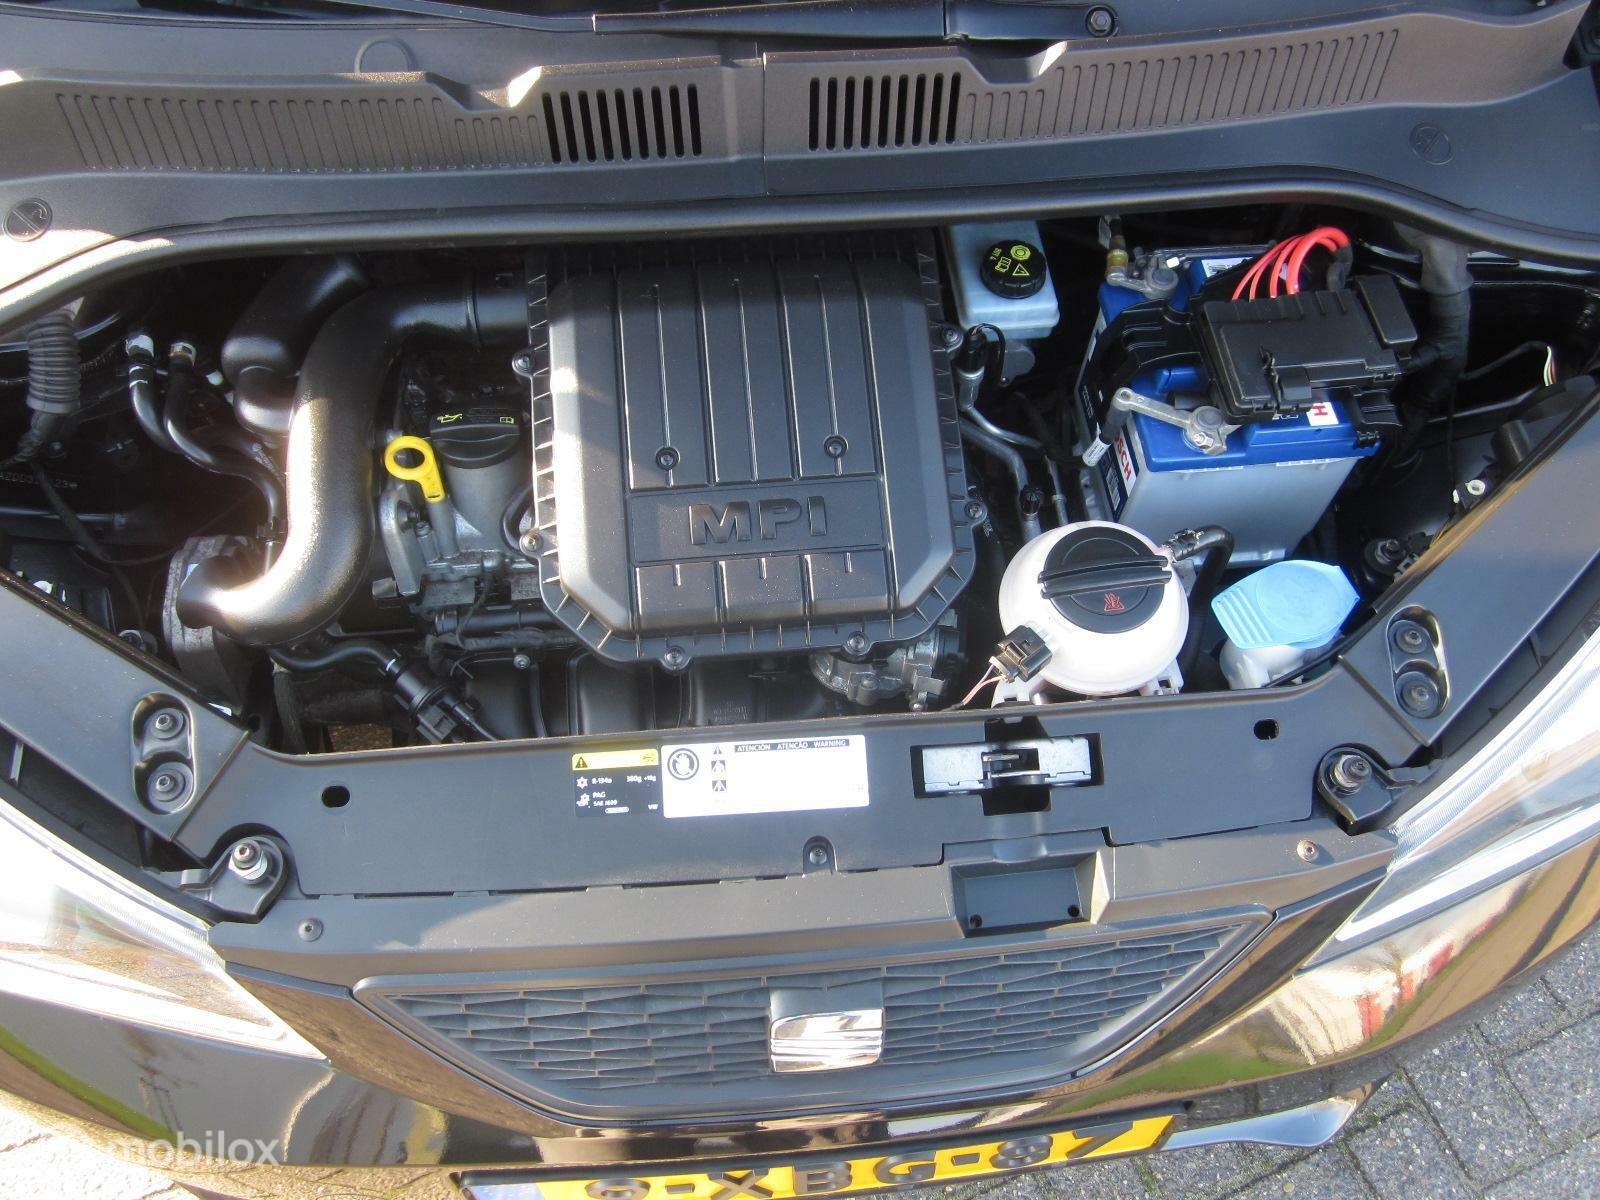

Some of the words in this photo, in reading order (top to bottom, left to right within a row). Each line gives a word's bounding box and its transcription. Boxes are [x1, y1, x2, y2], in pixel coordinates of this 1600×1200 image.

[688, 496, 827, 545] MPI
[813, 739, 847, 749] WARNING
[592, 791, 607, 799] PAG
